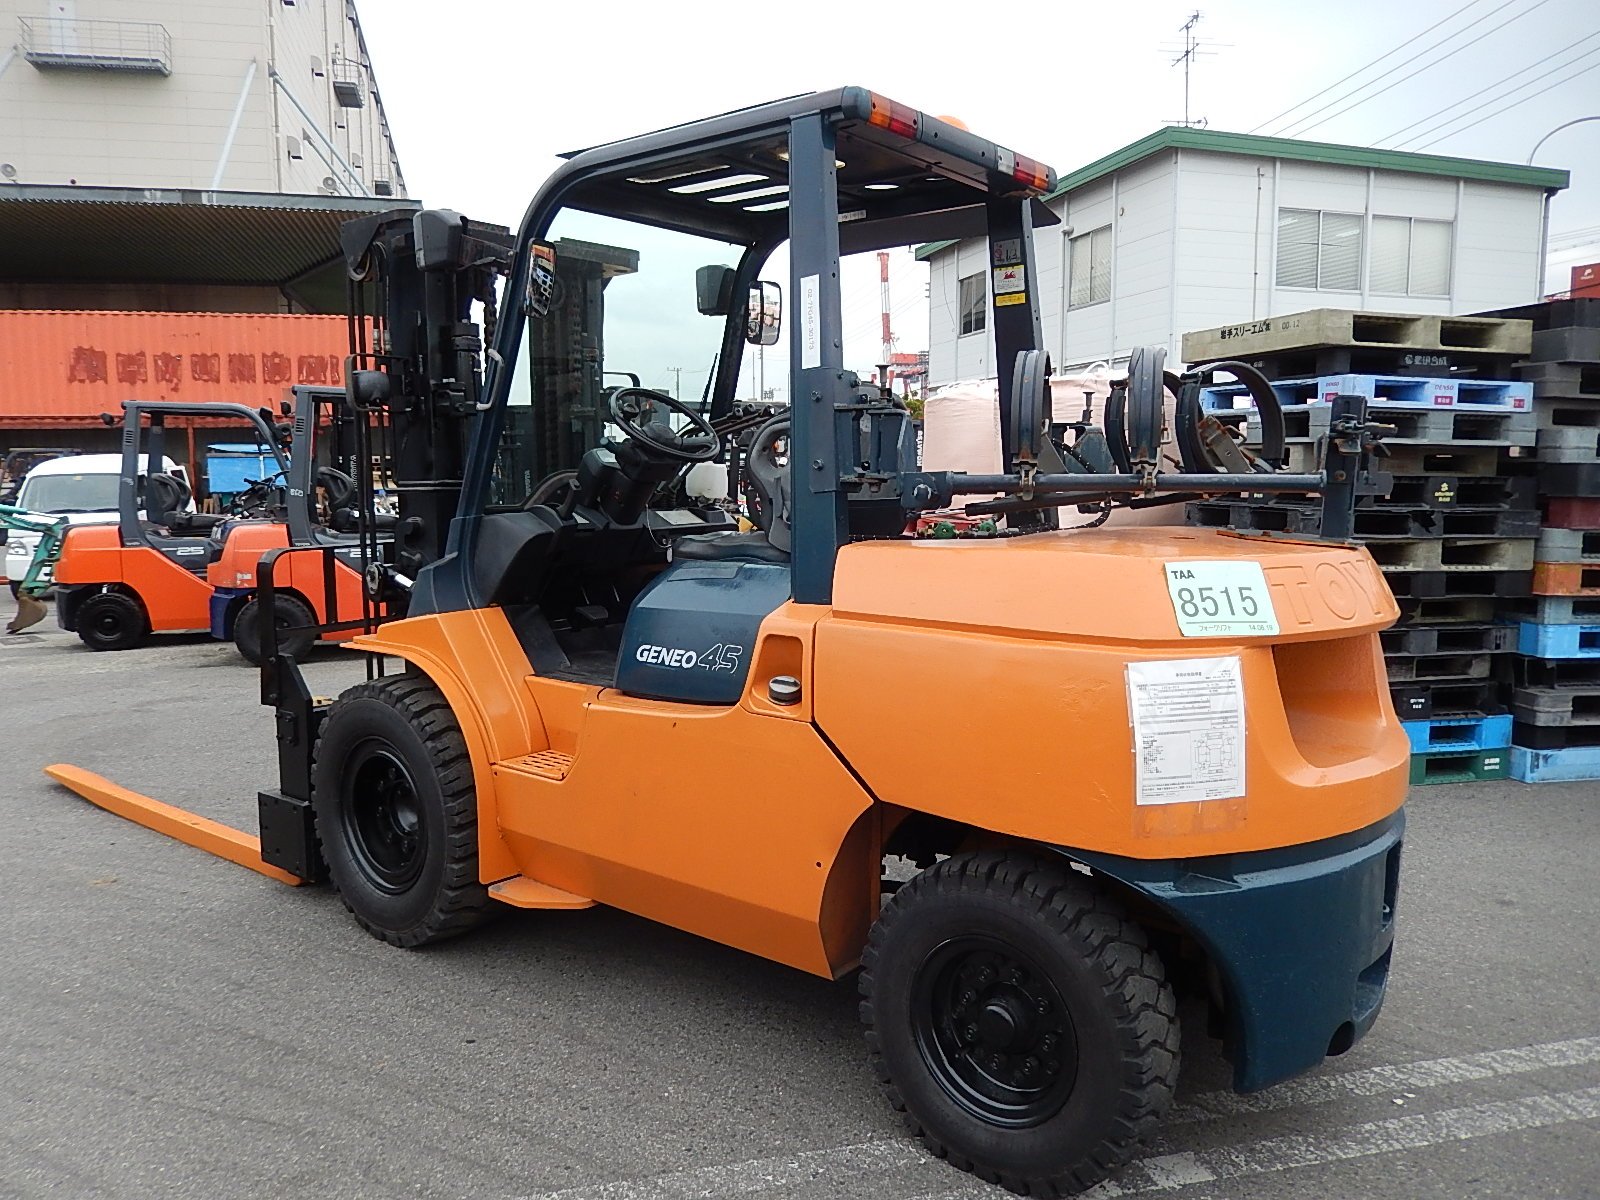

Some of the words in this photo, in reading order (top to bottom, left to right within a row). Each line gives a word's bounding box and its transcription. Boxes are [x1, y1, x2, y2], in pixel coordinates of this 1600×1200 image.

[176, 546, 205, 556] 25
[1171, 570, 1195, 579] TAA
[1177, 586, 1258, 617] 8515
[1263, 557, 1398, 625] TOY
[636, 644, 697, 669] GENEO
[697, 643, 743, 674] 45
